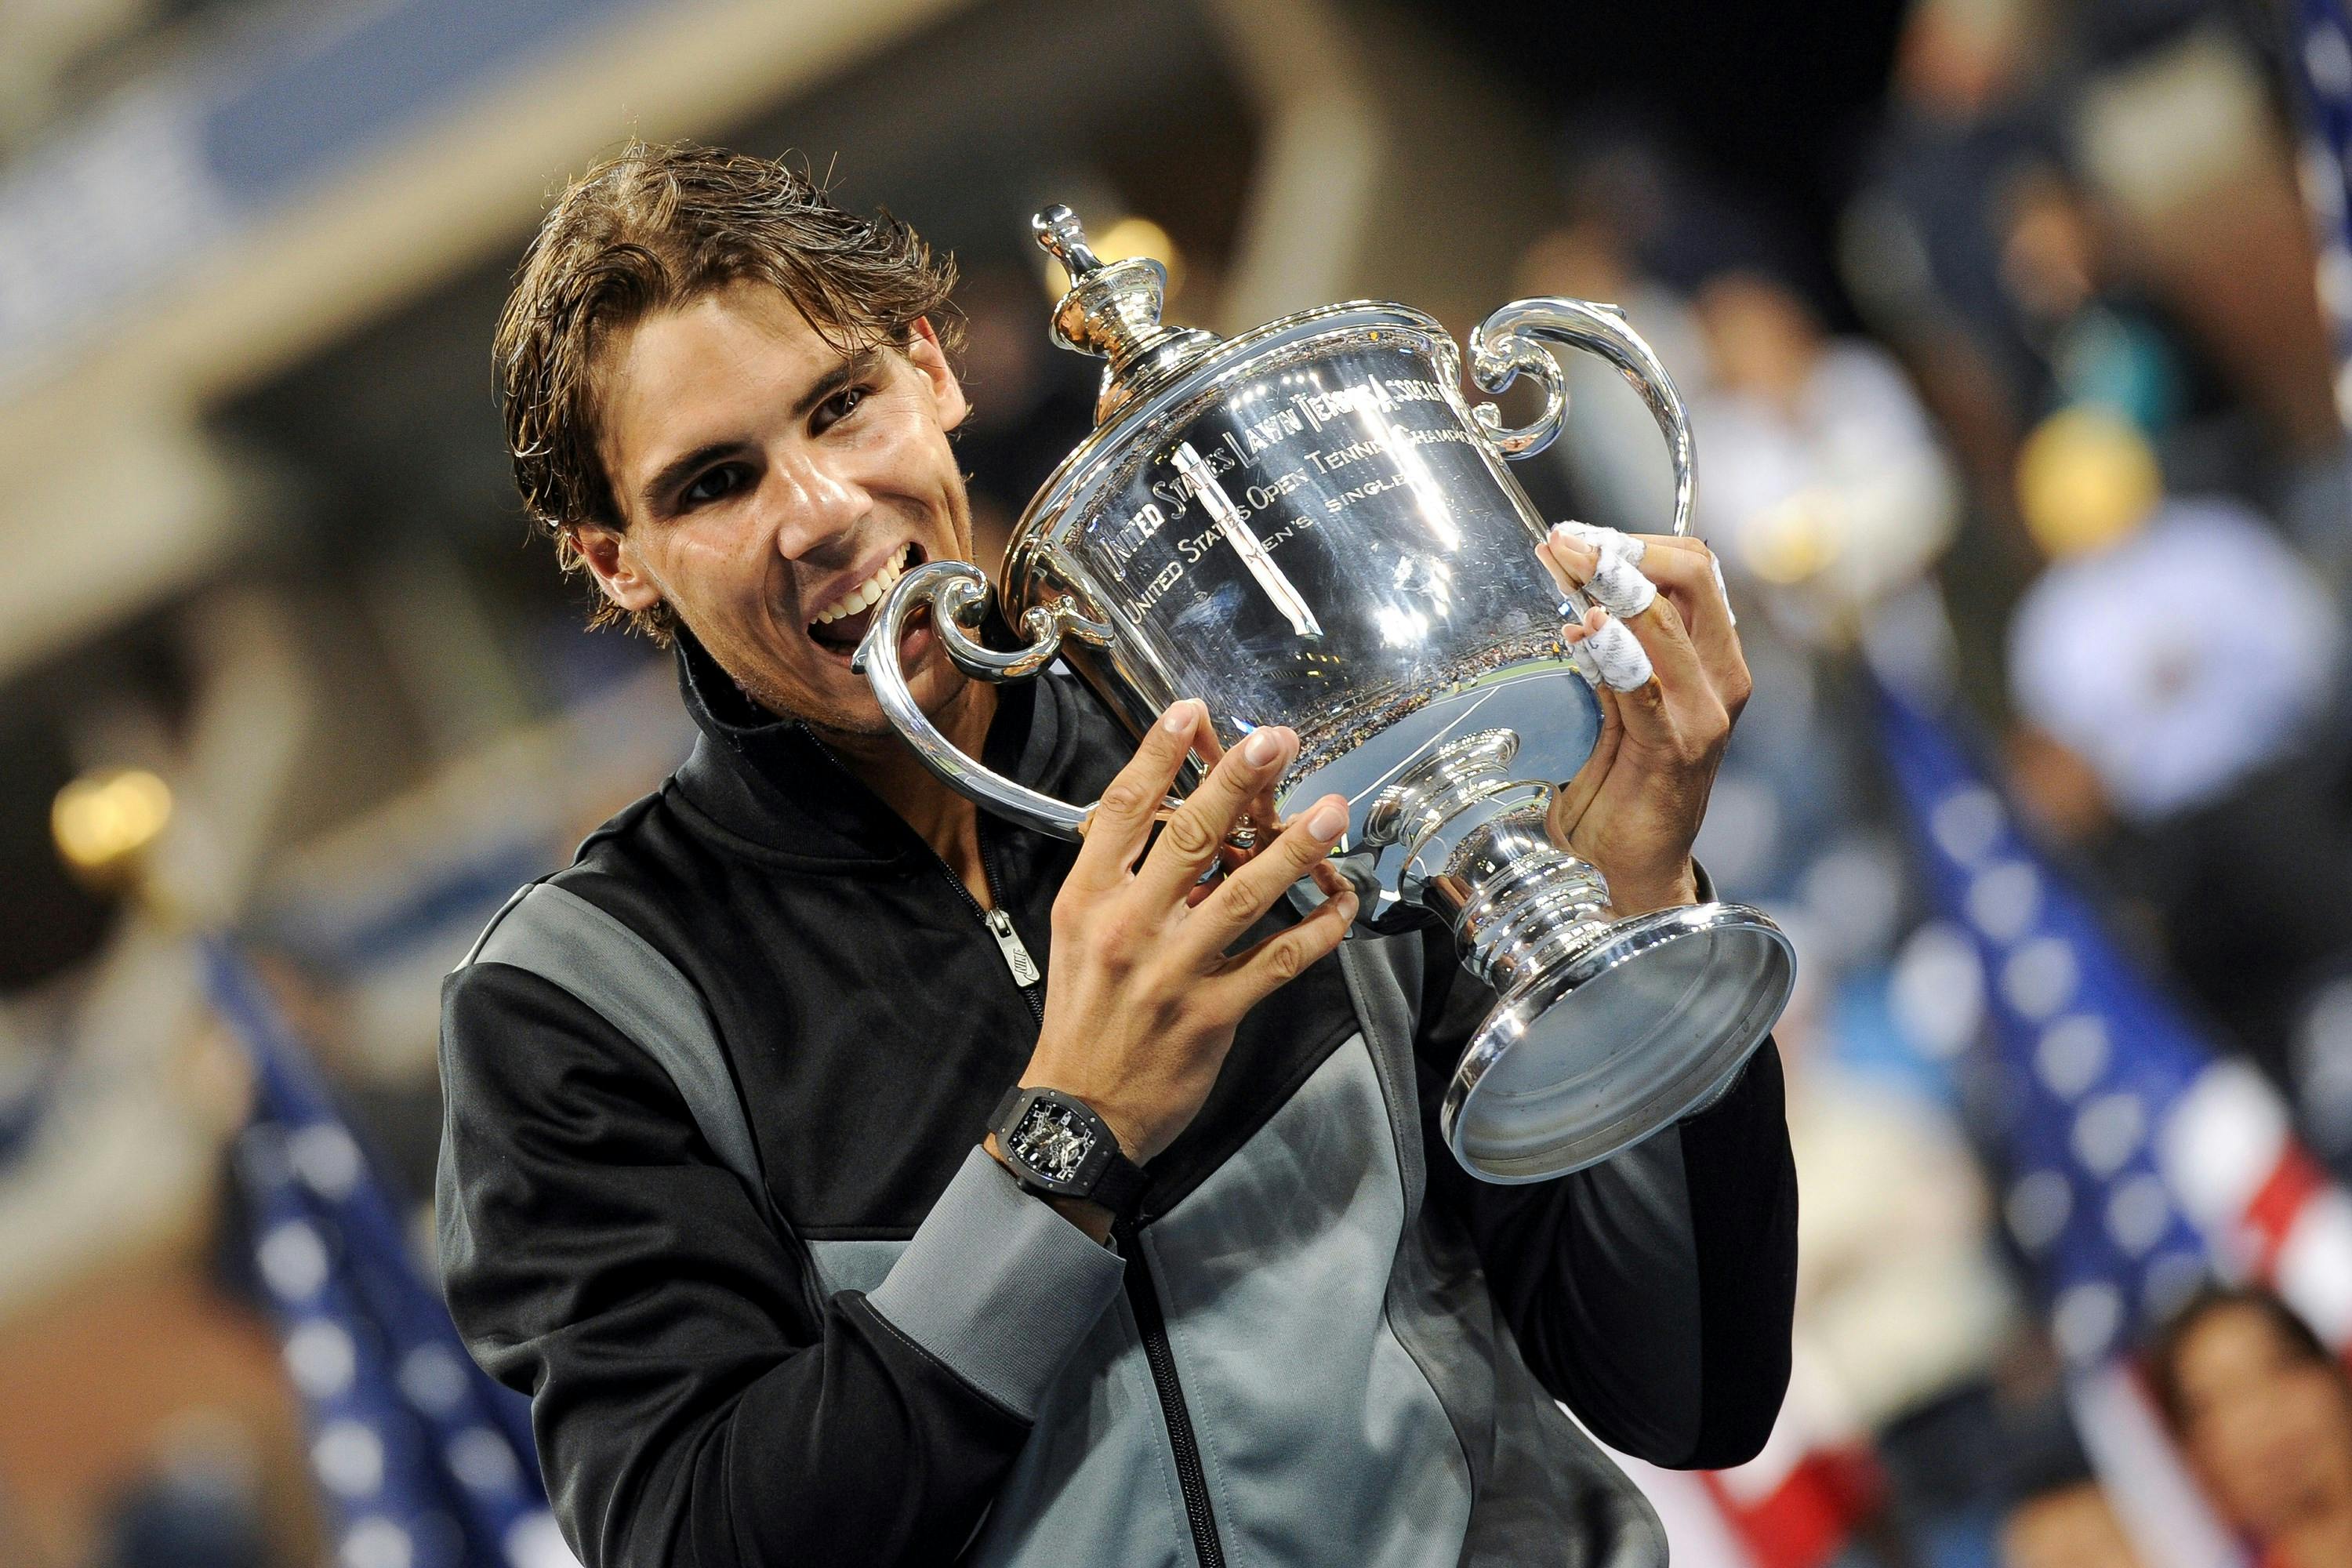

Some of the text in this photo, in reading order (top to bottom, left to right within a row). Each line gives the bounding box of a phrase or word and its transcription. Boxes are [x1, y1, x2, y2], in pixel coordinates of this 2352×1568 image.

[1099, 503, 1165, 582] UNITED
[1152, 447, 1236, 520] STATES
[1221, 408, 1304, 469] LAWN
[1122, 561, 1184, 625] UNITED
[1178, 504, 1252, 564] STATES
[1246, 467, 1310, 510] OPEN
[1303, 439, 1388, 474] TENNI
[1246, 515, 1314, 564] MEN'S
[1013, 948, 1027, 975] NIKE
